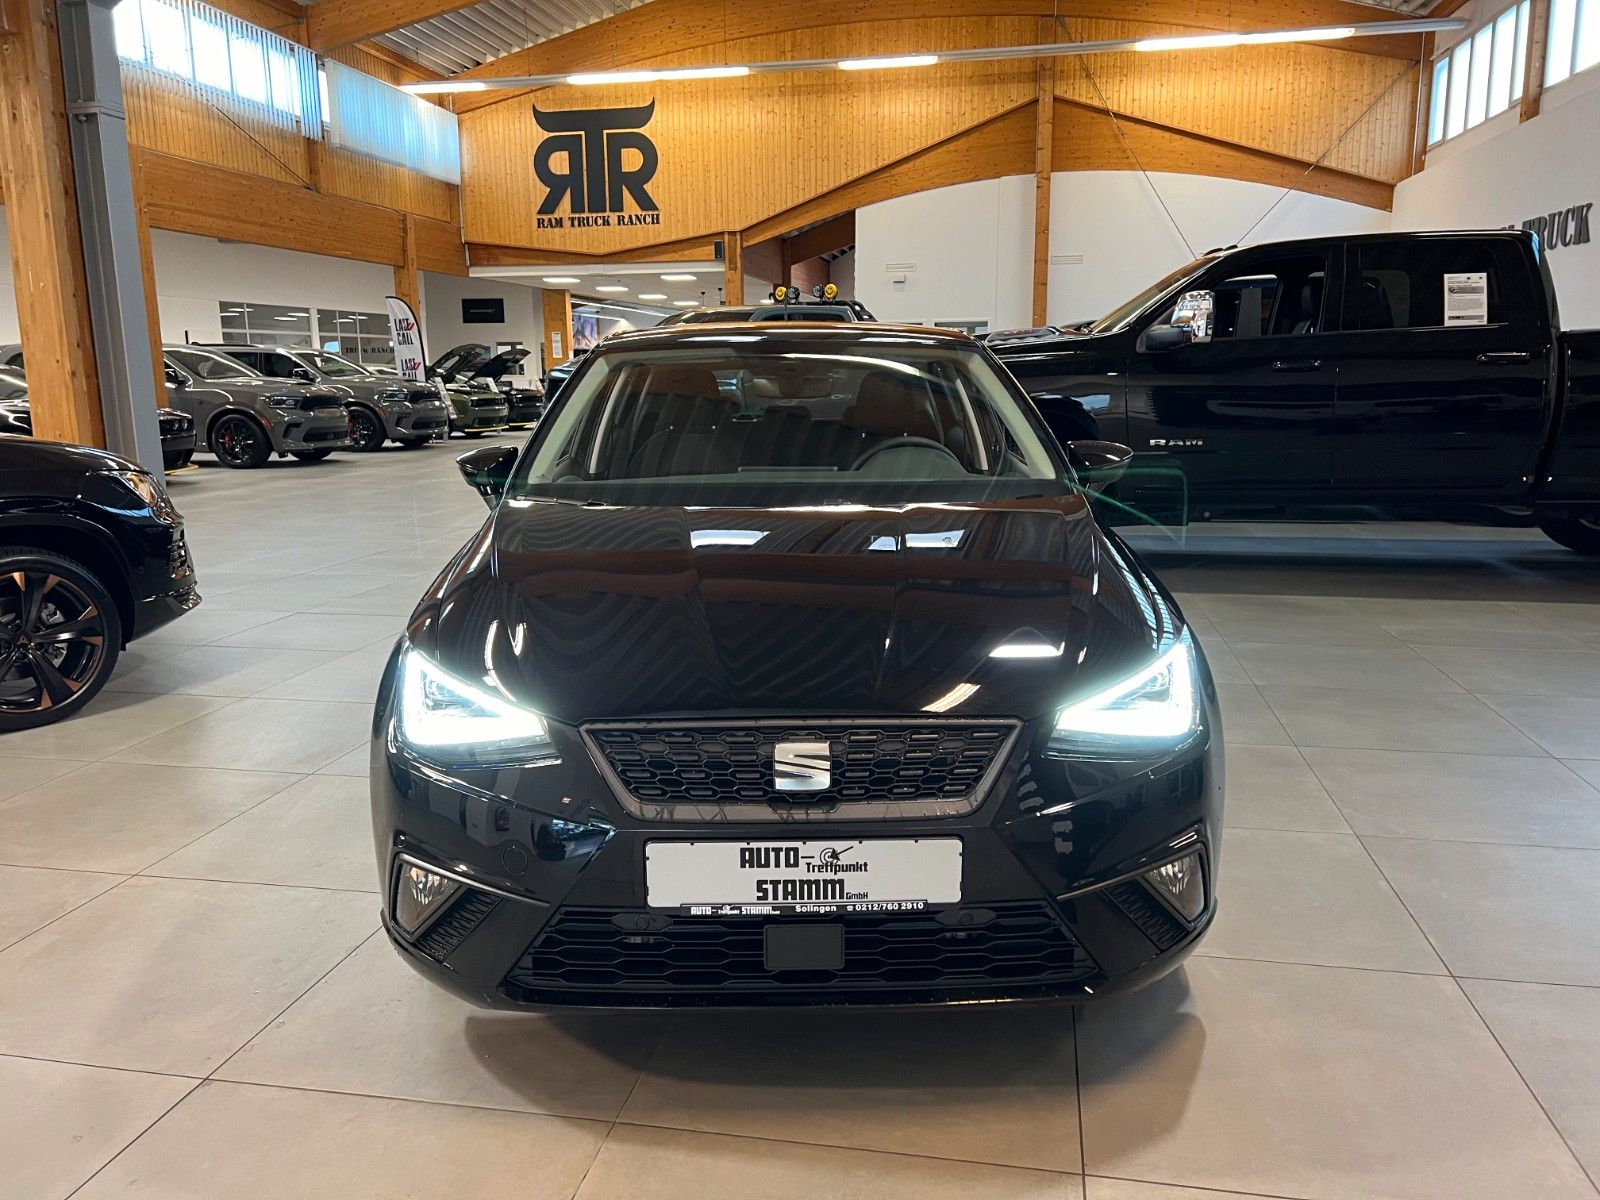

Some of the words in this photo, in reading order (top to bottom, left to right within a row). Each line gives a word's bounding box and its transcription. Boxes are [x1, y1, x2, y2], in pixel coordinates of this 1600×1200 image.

[536, 216, 564, 229] RAM
[568, 215, 611, 228] TRUCK
[617, 214, 660, 226] RANCH
[394, 318, 410, 332] LAST
[397, 332, 414, 345] CALL
[401, 358, 416, 372] LAST
[1149, 438, 1204, 446] RAM
[805, 862, 869, 875] Treffpunkt
[756, 879, 845, 901] STAMM
[845, 892, 869, 900] GmbH
[741, 906, 772, 915] STAMM
[795, 905, 837, 914] Solingen
[855, 903, 898, 912] 0212/760
[900, 902, 924, 910] 2910
